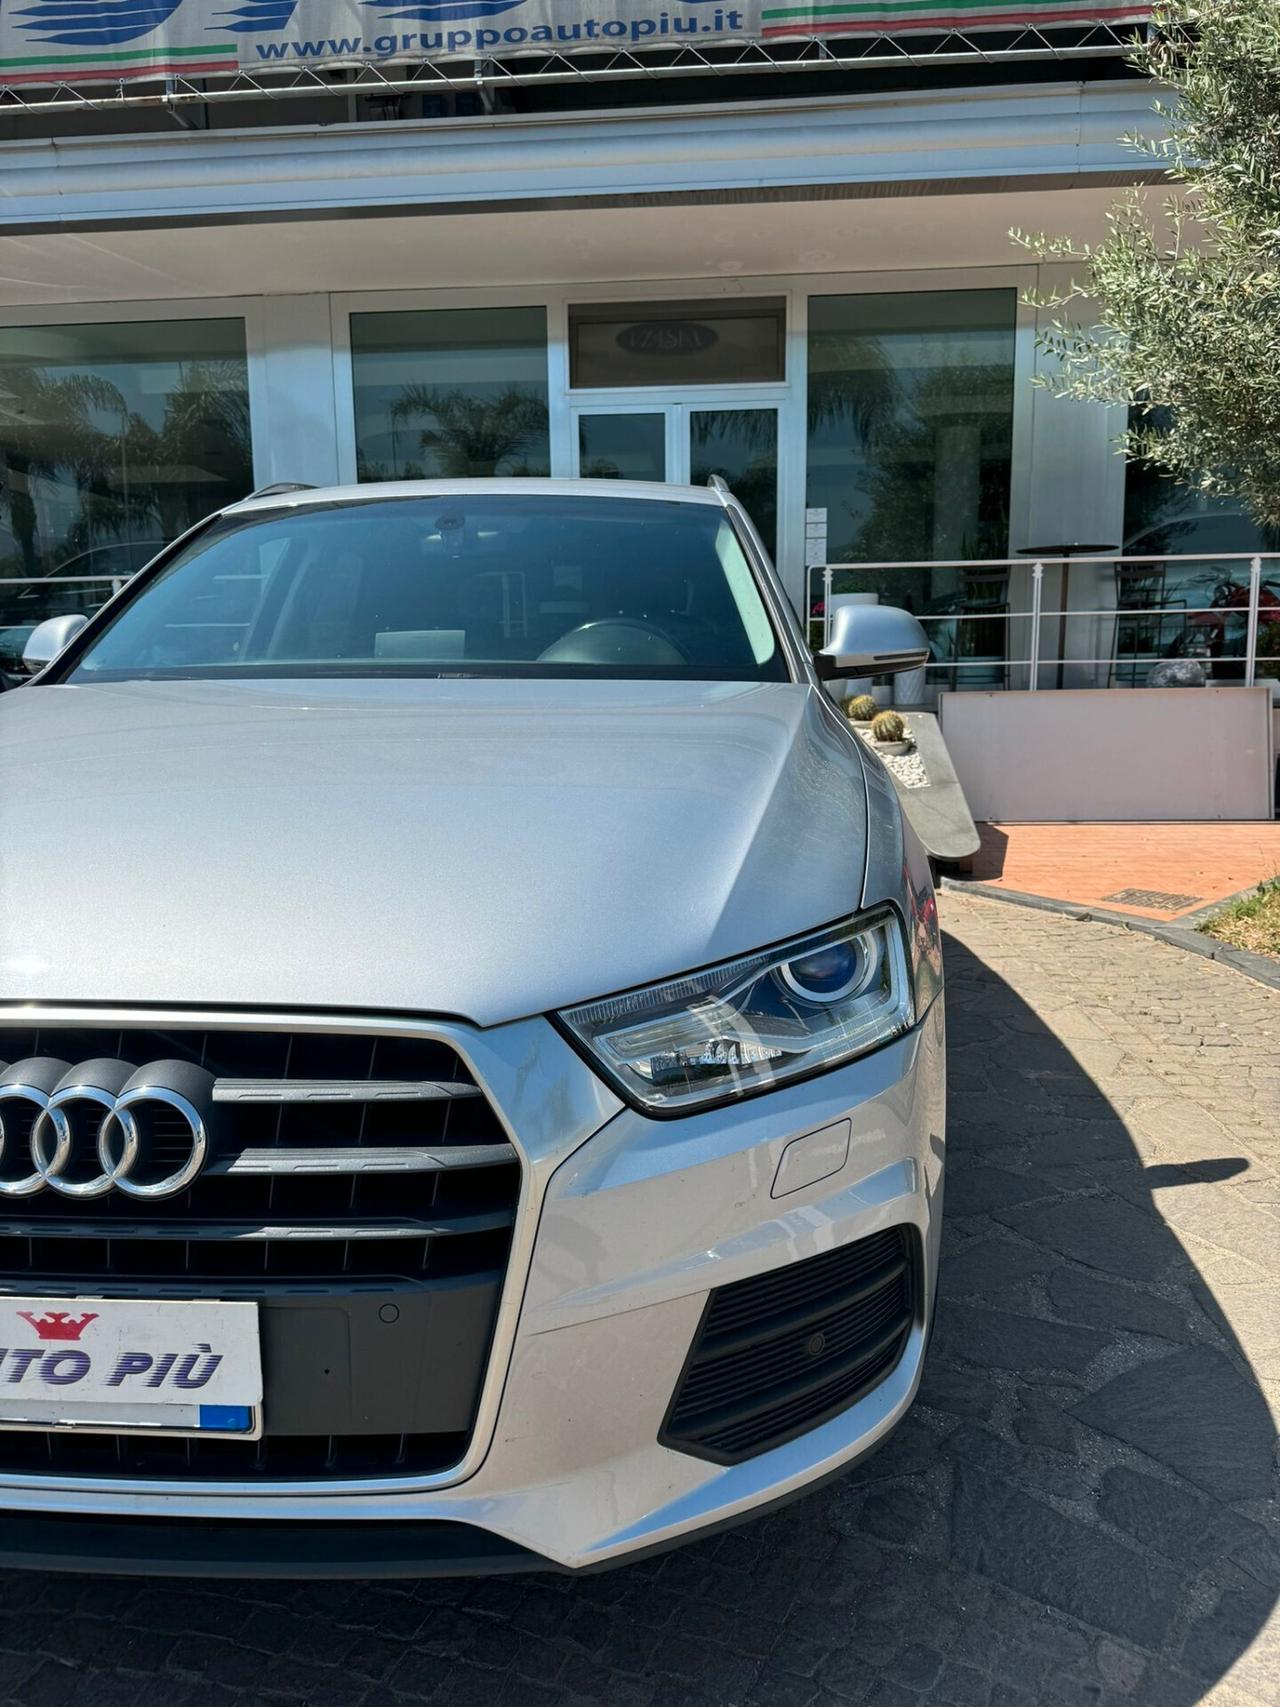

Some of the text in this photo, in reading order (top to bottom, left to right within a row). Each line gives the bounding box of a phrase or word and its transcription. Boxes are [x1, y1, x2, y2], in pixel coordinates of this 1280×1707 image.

[255, 9, 743, 59] www.gruppoautopiu.it
[0, 1343, 223, 1389] TO PIÙ
